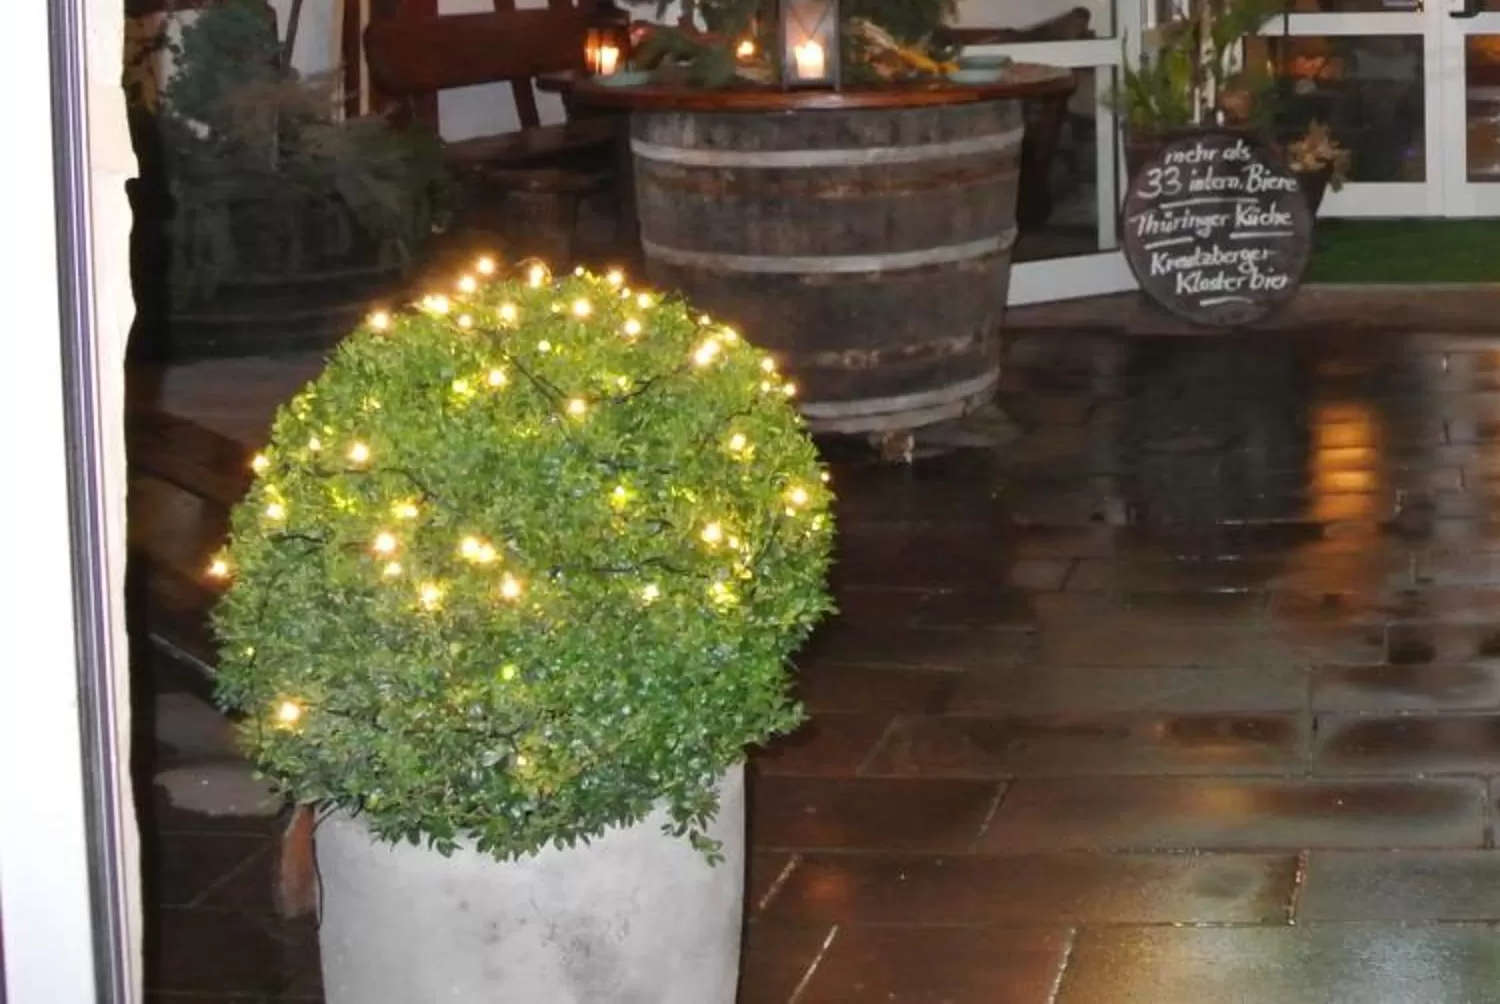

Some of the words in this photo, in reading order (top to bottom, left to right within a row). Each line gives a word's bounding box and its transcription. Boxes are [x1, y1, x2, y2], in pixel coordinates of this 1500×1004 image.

[1164, 143, 1218, 164] mehr
[1222, 138, 1251, 161] als
[1136, 165, 1183, 199] 33
[1242, 163, 1297, 193] Biere
[1129, 207, 1231, 239] Thüringer
[1235, 200, 1293, 227] Küche
